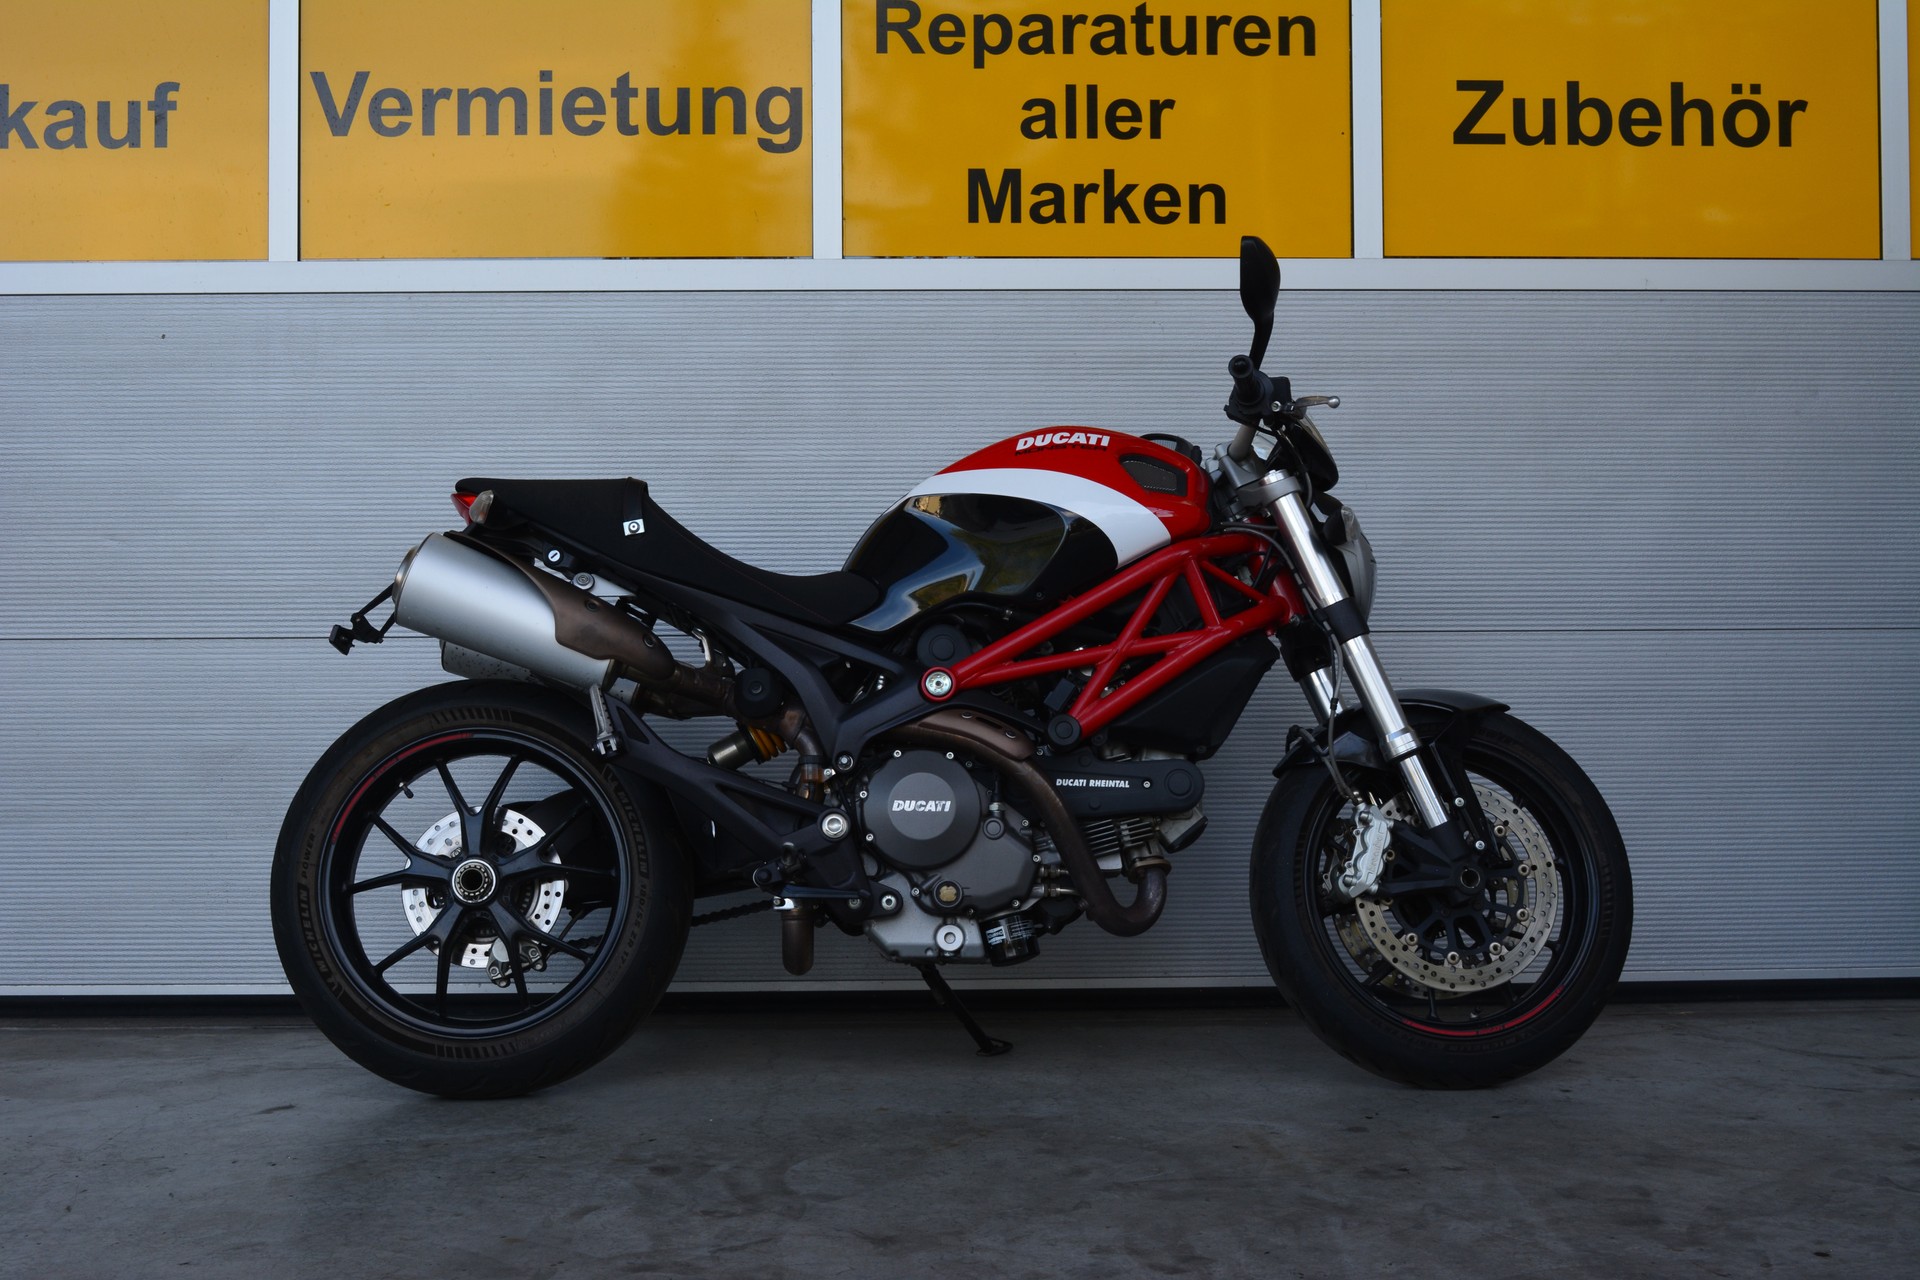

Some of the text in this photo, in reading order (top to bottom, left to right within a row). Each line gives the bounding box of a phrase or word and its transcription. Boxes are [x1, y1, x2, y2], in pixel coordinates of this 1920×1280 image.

[875, 0, 1316, 69] Reparaturen
[0, 81, 180, 150] kauf
[309, 70, 804, 154] Vermietung
[1020, 84, 1176, 140] aller
[1453, 80, 1808, 148] Zubehör
[967, 168, 1226, 224] Marken
[1016, 432, 1110, 451] DUCATI
[892, 799, 951, 812] DUCATI
[1056, 778, 1130, 788] DUCATI RHEINTAL
[616, 790, 650, 875] MICHELIN
[298, 833, 331, 979] MICHELIN POWER
